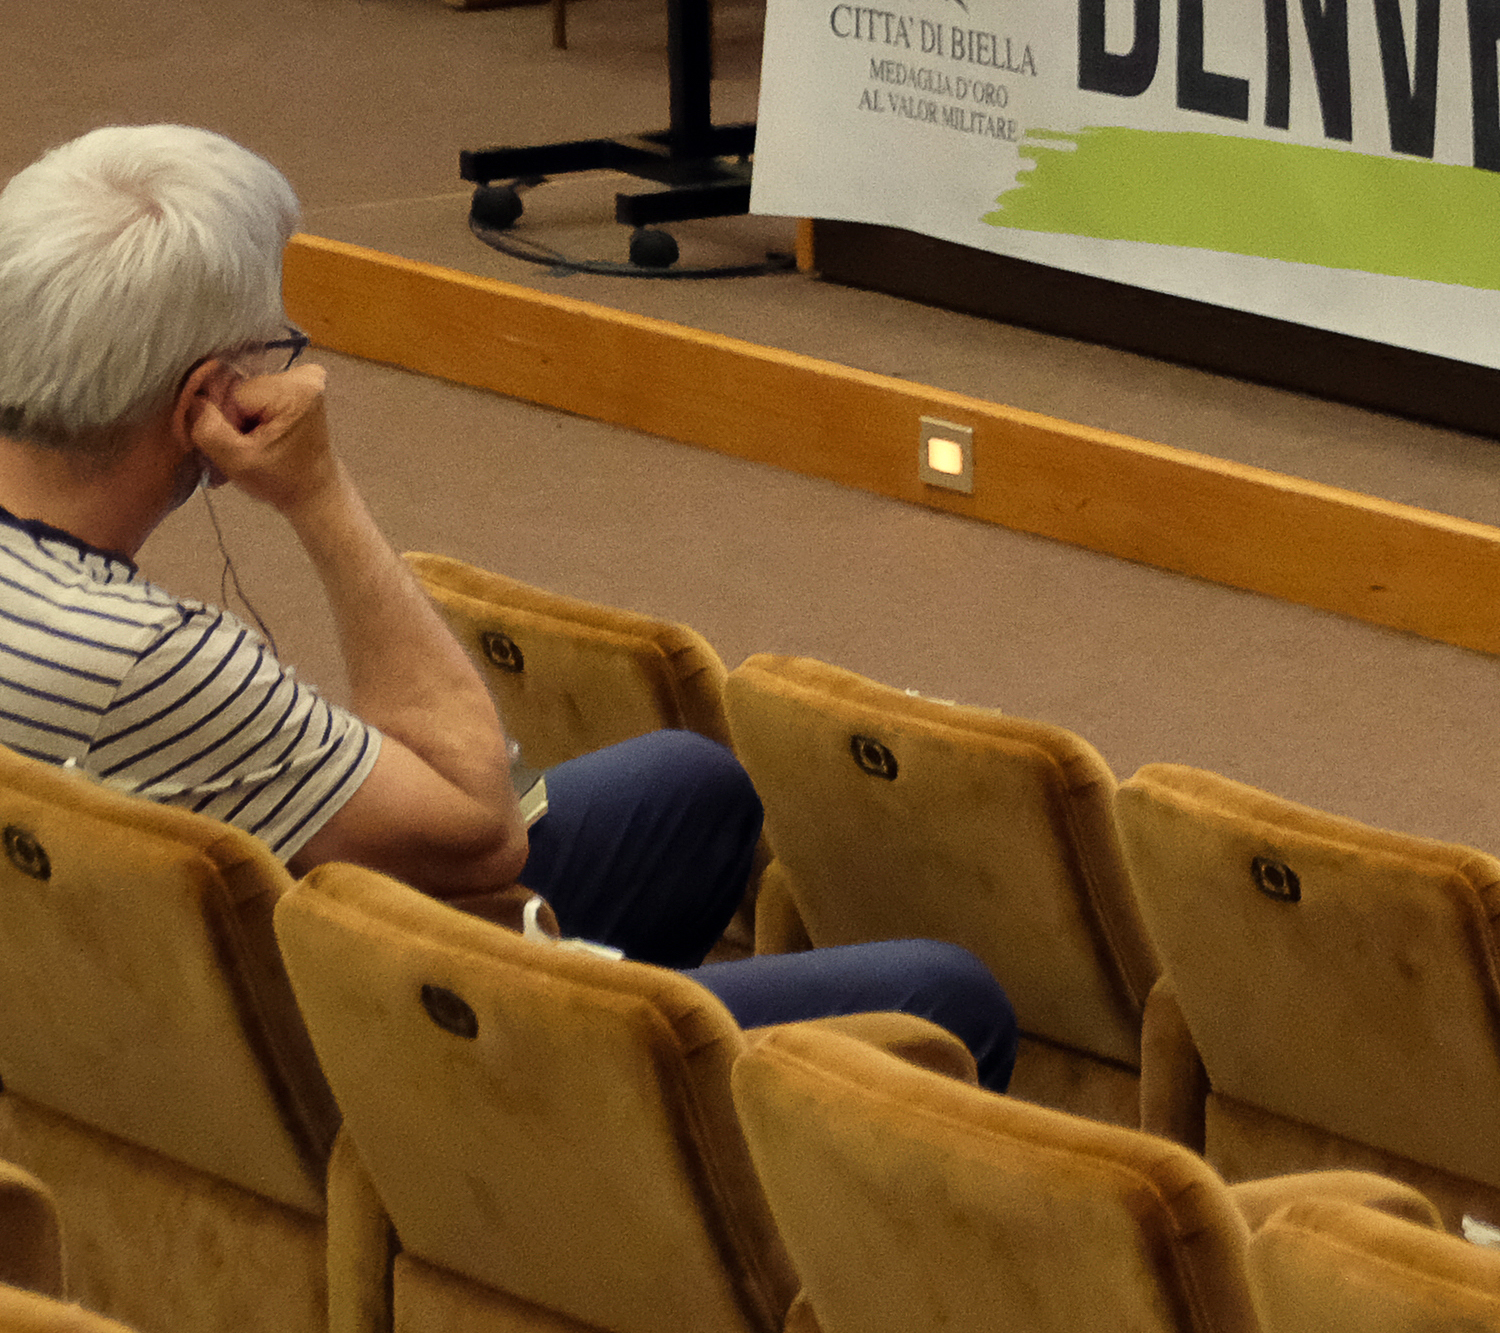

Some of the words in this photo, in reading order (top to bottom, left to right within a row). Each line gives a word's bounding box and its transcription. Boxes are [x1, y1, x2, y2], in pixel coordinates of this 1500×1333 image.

[830, 3, 914, 49] CITTA'
[920, 19, 944, 56] DI
[951, 26, 1038, 77] BIELLA
[869, 58, 955, 96] MEDAGLIA
[955, 76, 1009, 109] D'ORO
[857, 88, 884, 113] AL
[888, 91, 938, 124] VALOR
[942, 105, 1018, 143] MILITARE
